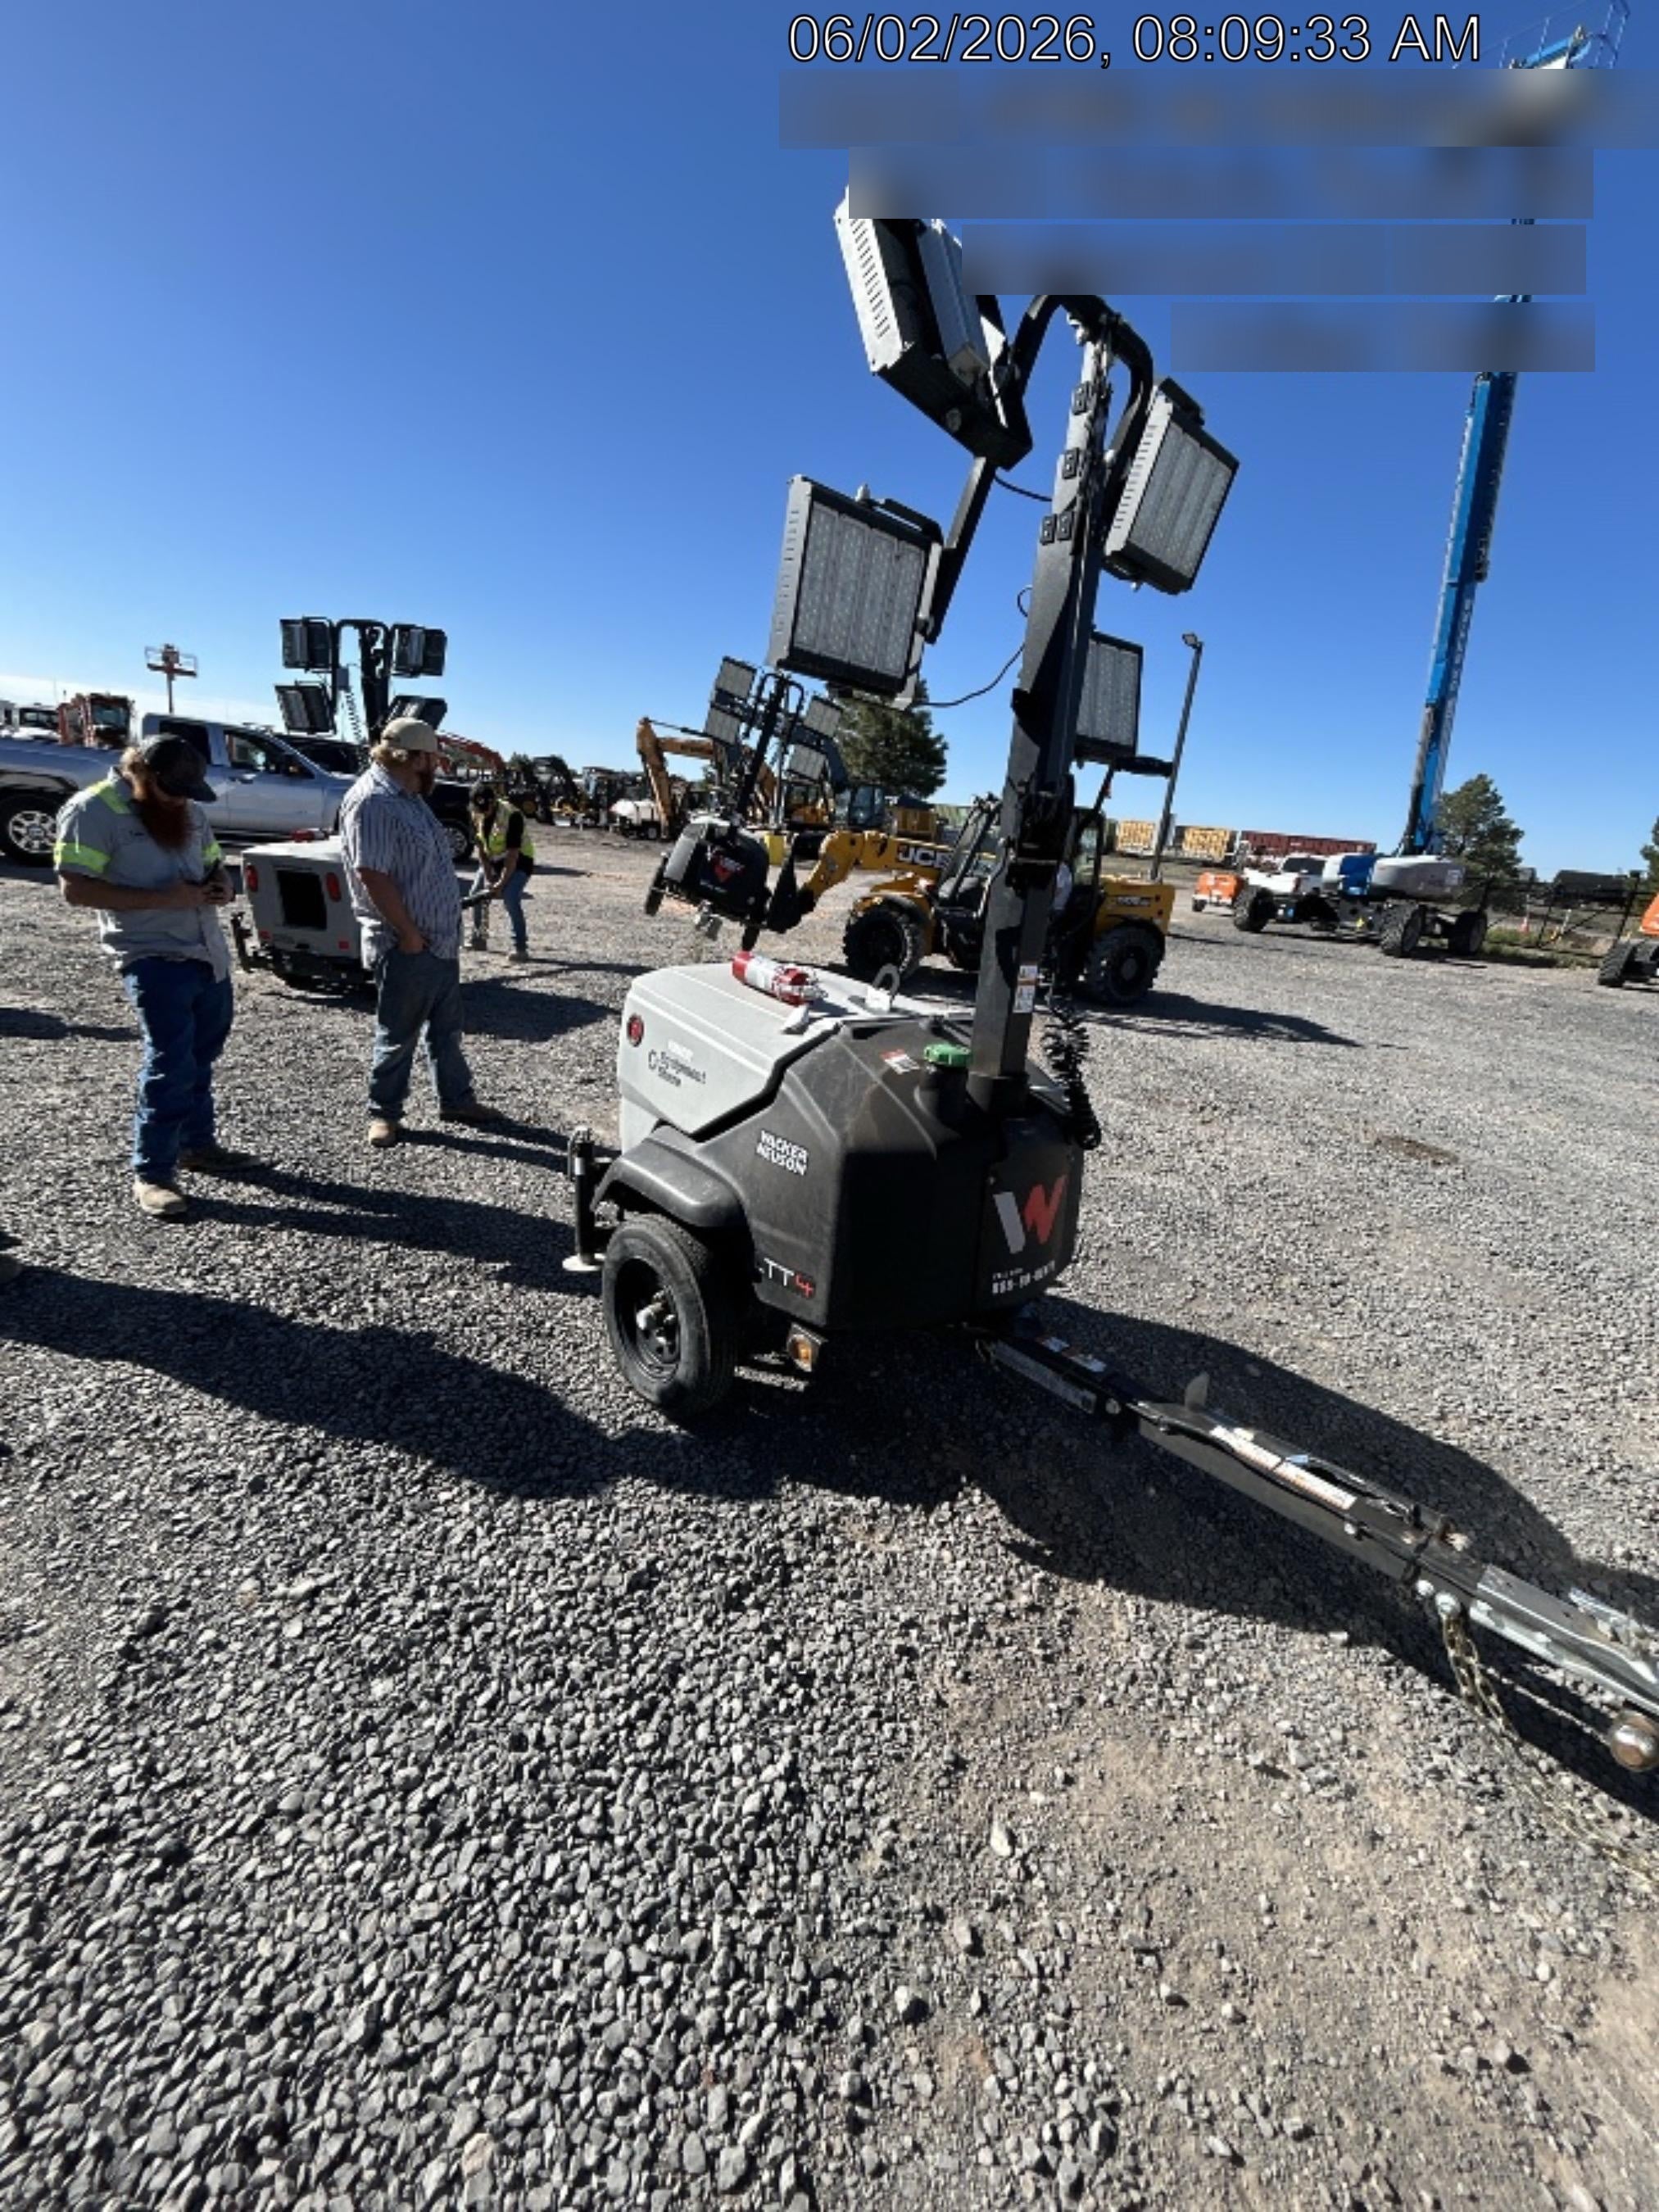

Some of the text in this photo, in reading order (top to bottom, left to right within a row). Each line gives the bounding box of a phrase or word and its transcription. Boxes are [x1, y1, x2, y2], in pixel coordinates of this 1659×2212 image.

[756, 1142, 807, 1176] NEUSON
[760, 1130, 807, 1163] WACKER
[758, 1257, 814, 1299] TT4
